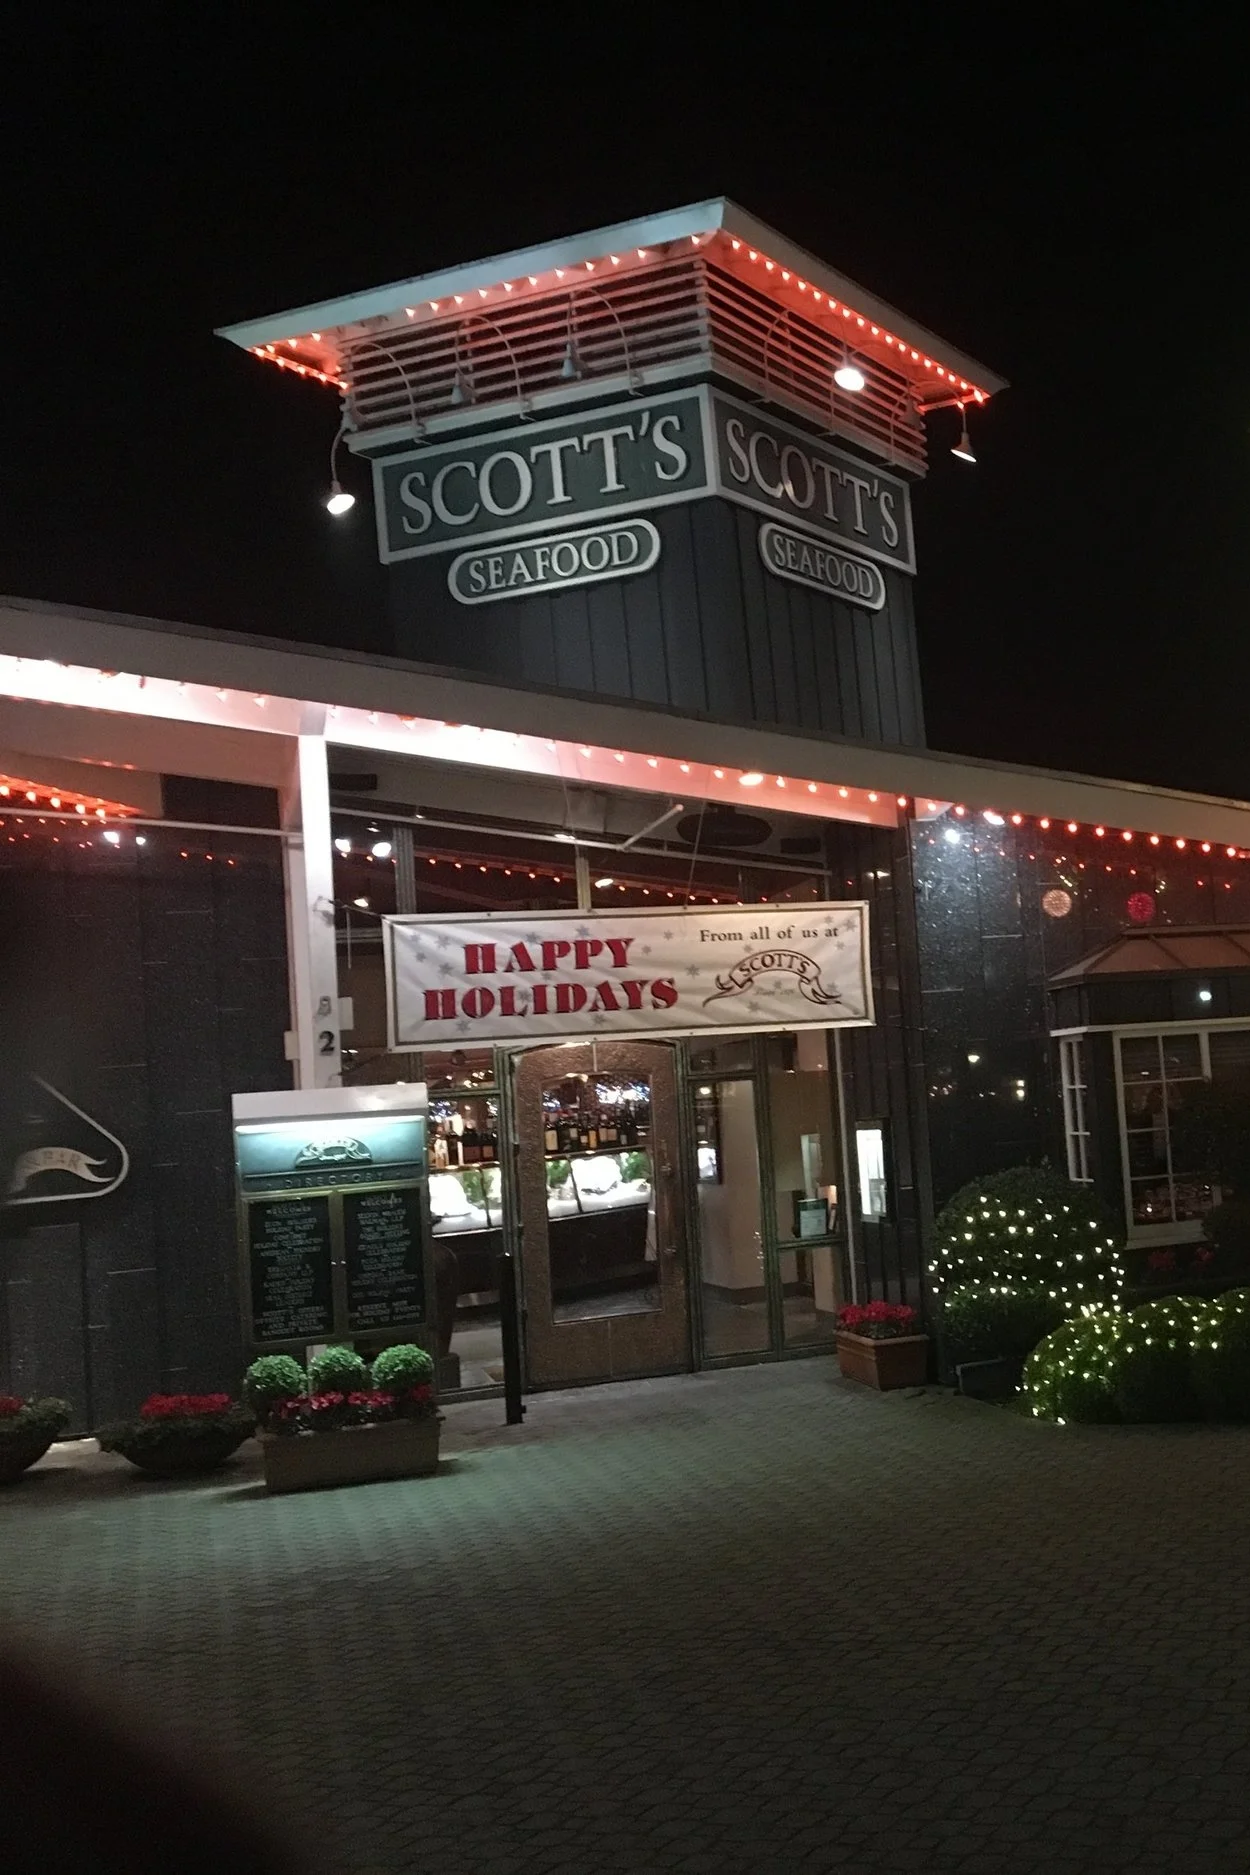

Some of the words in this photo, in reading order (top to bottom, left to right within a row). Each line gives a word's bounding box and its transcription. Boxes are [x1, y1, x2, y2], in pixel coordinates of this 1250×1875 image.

[400, 412, 688, 534] SCOTT'S
[726, 418, 898, 548] SCOTT'S
[468, 530, 639, 593] SEAFOOD
[773, 534, 874, 599] SEAFOOD
[462, 937, 636, 974] HAPPY
[700, 929, 743, 942] From
[750, 926, 770, 940] all
[777, 925, 795, 939] of
[802, 927, 818, 938] us
[825, 927, 839, 937] at
[423, 977, 679, 1021] HOLIDAYS
[319, 1030, 335, 1053] 2
[285, 1172, 384, 1188] DIRECTORY
